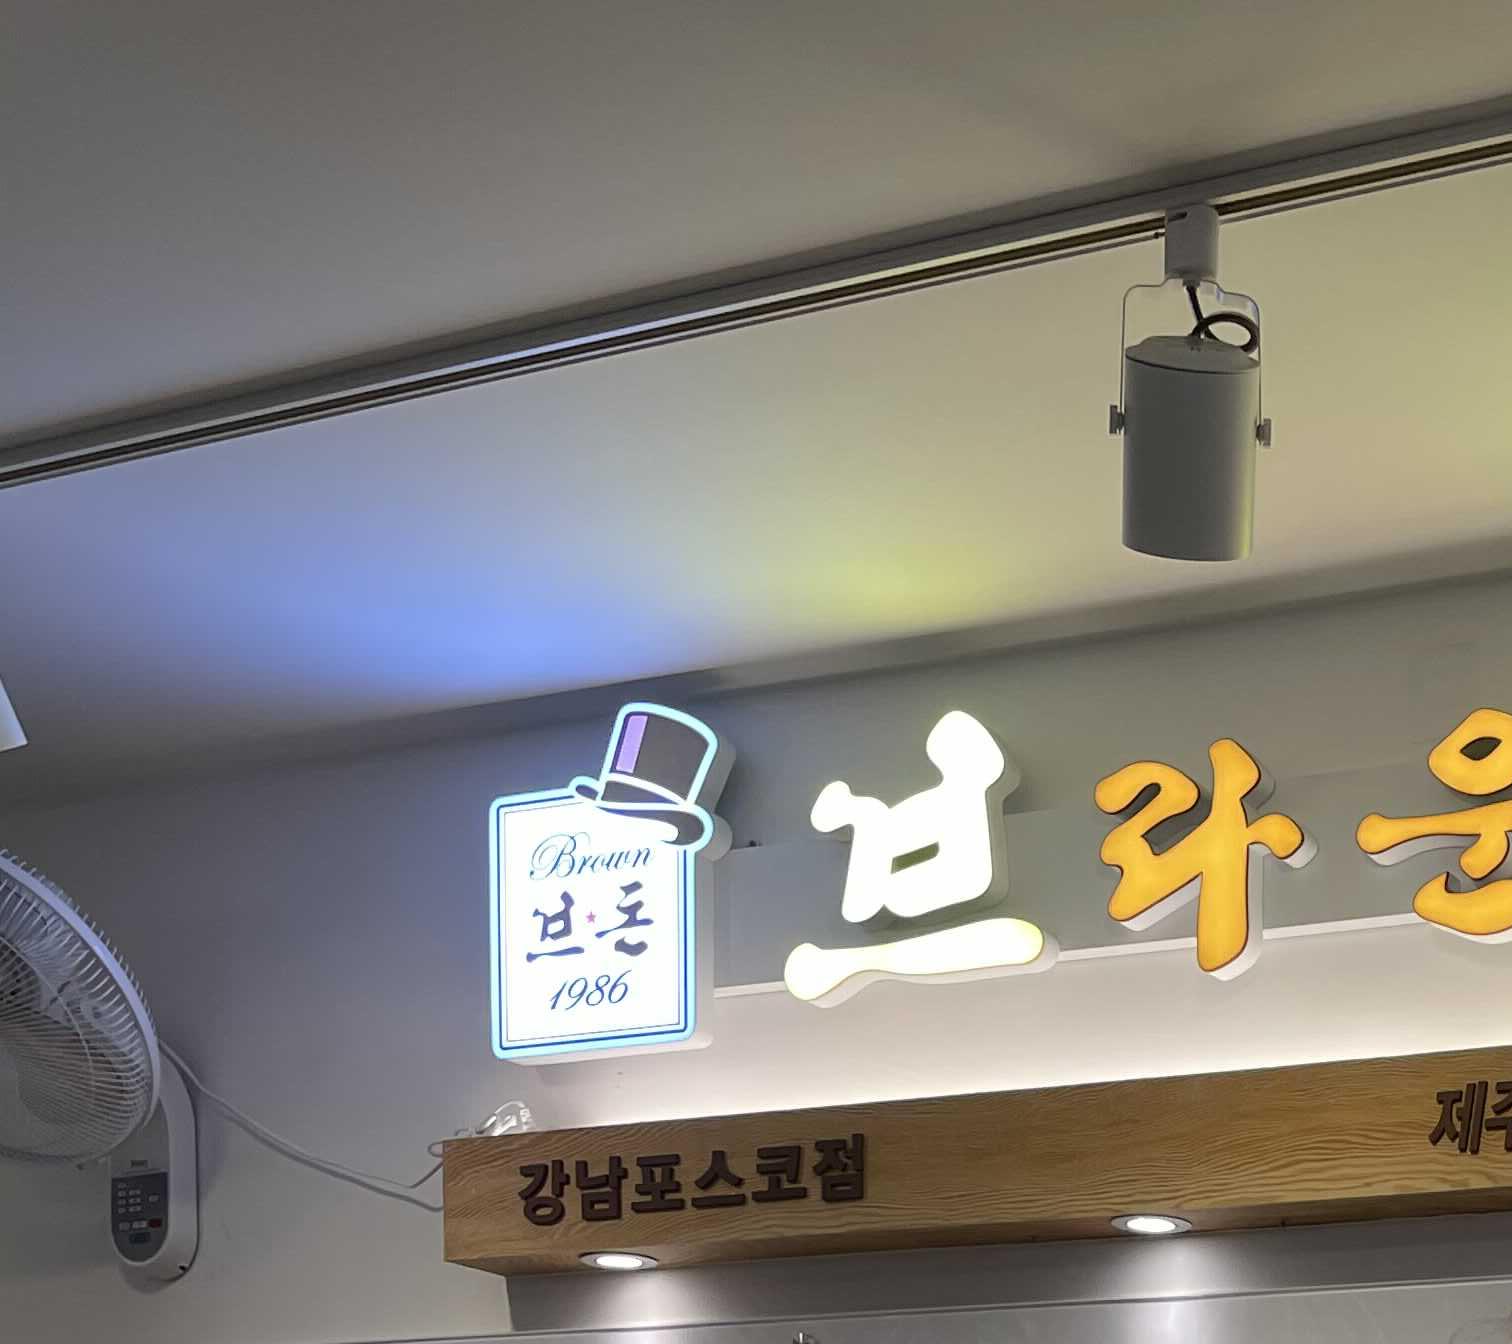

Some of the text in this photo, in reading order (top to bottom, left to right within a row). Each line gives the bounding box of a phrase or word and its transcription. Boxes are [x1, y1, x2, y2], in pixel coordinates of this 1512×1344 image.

[529, 831, 655, 880] Brown
[550, 970, 632, 1011] 1986
[517, 1134, 866, 1227] 강남포스코점
